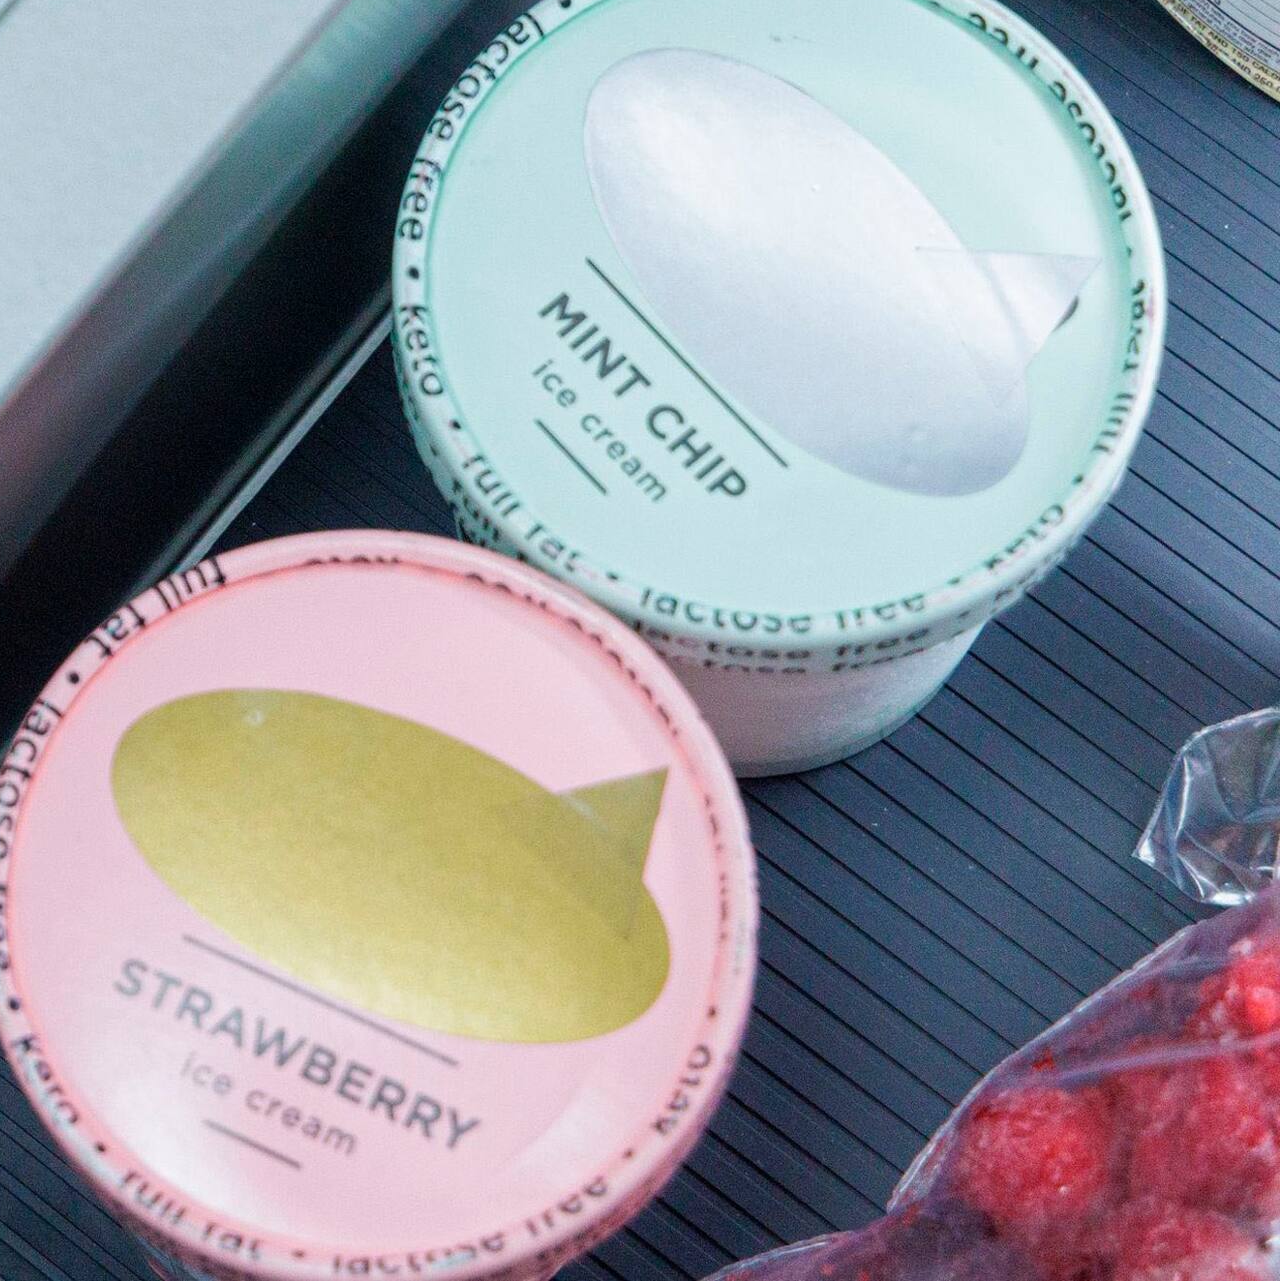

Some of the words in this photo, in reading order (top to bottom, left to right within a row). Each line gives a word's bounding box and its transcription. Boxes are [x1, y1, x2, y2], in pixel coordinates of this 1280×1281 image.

[426, 11, 546, 142] lactose
[397, 156, 445, 241] free
[532, 358, 577, 408] ice
[580, 413, 668, 503] cream
[537, 291, 652, 399] MINT
[645, 404, 747, 498] CHIP
[85, 601, 147, 658] fat
[153, 557, 226, 613] full
[112, 956, 483, 1151] STRAWBERRY
[180, 1052, 233, 1096] ice
[244, 1085, 358, 1156] cream
